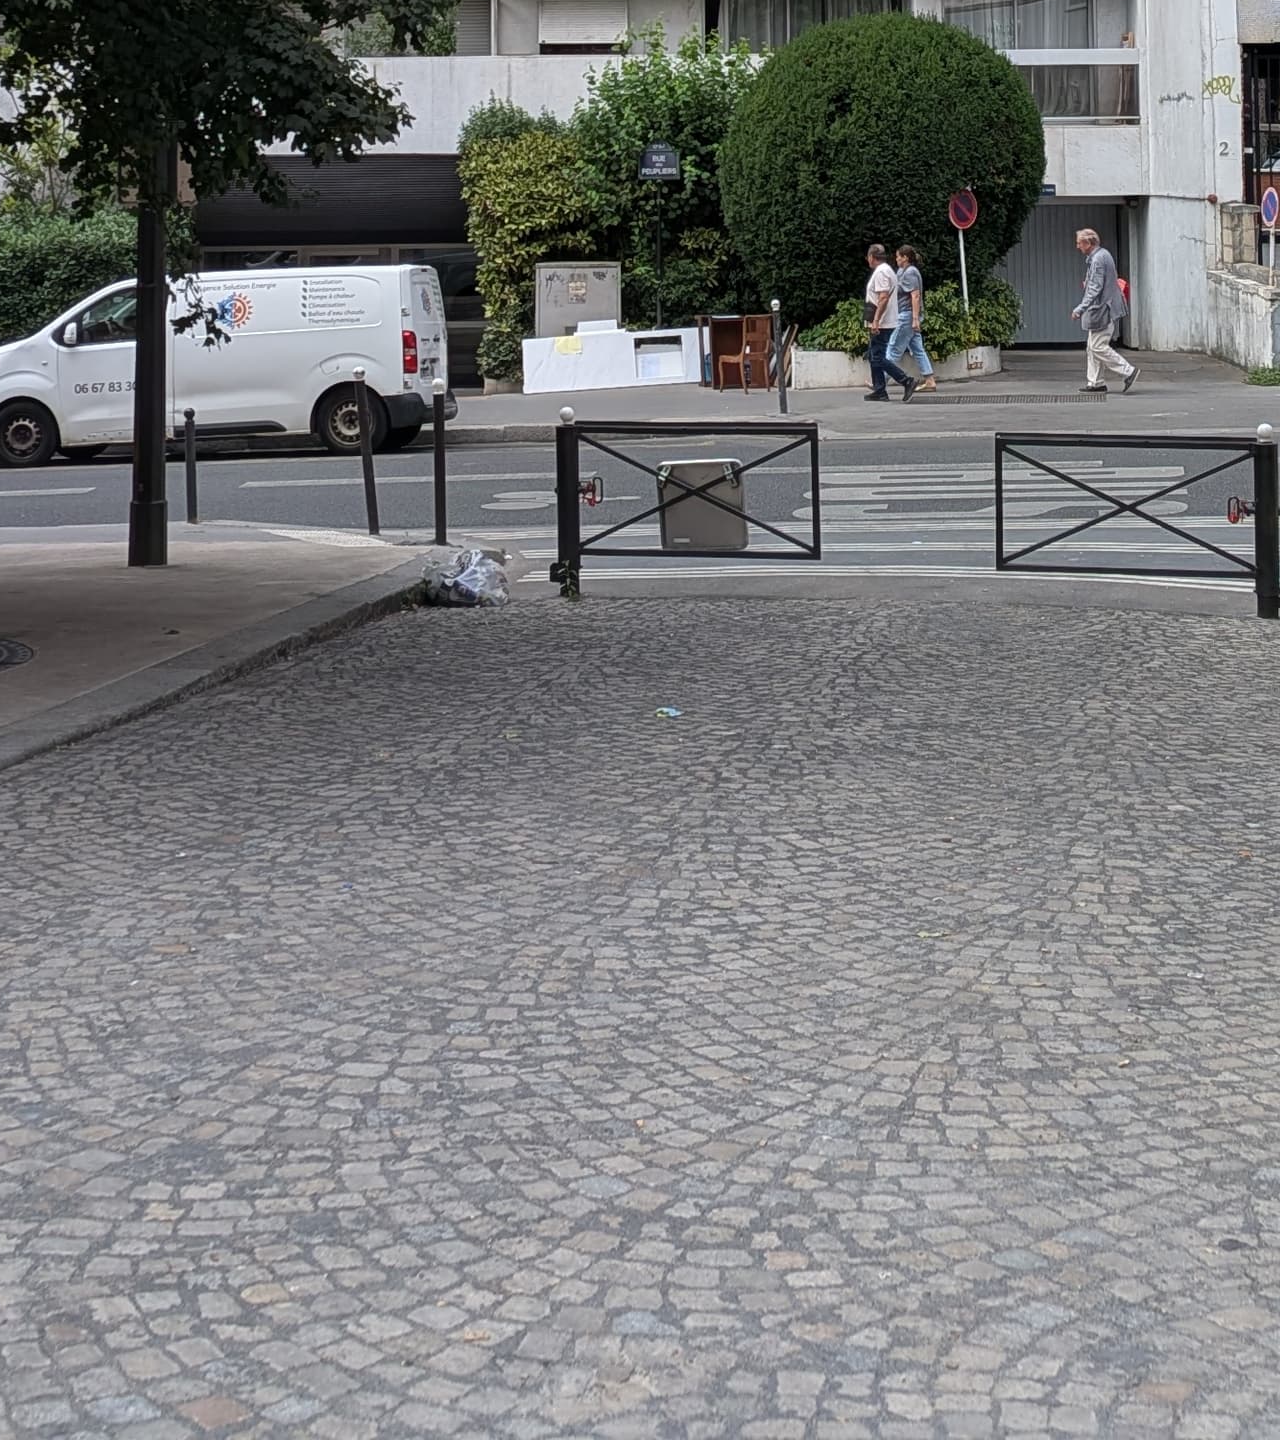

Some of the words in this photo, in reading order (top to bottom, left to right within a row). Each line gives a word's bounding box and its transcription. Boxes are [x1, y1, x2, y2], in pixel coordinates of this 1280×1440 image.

[74, 383, 89, 394] 06
[91, 382, 105, 393] 67
[108, 381, 122, 392] 83
